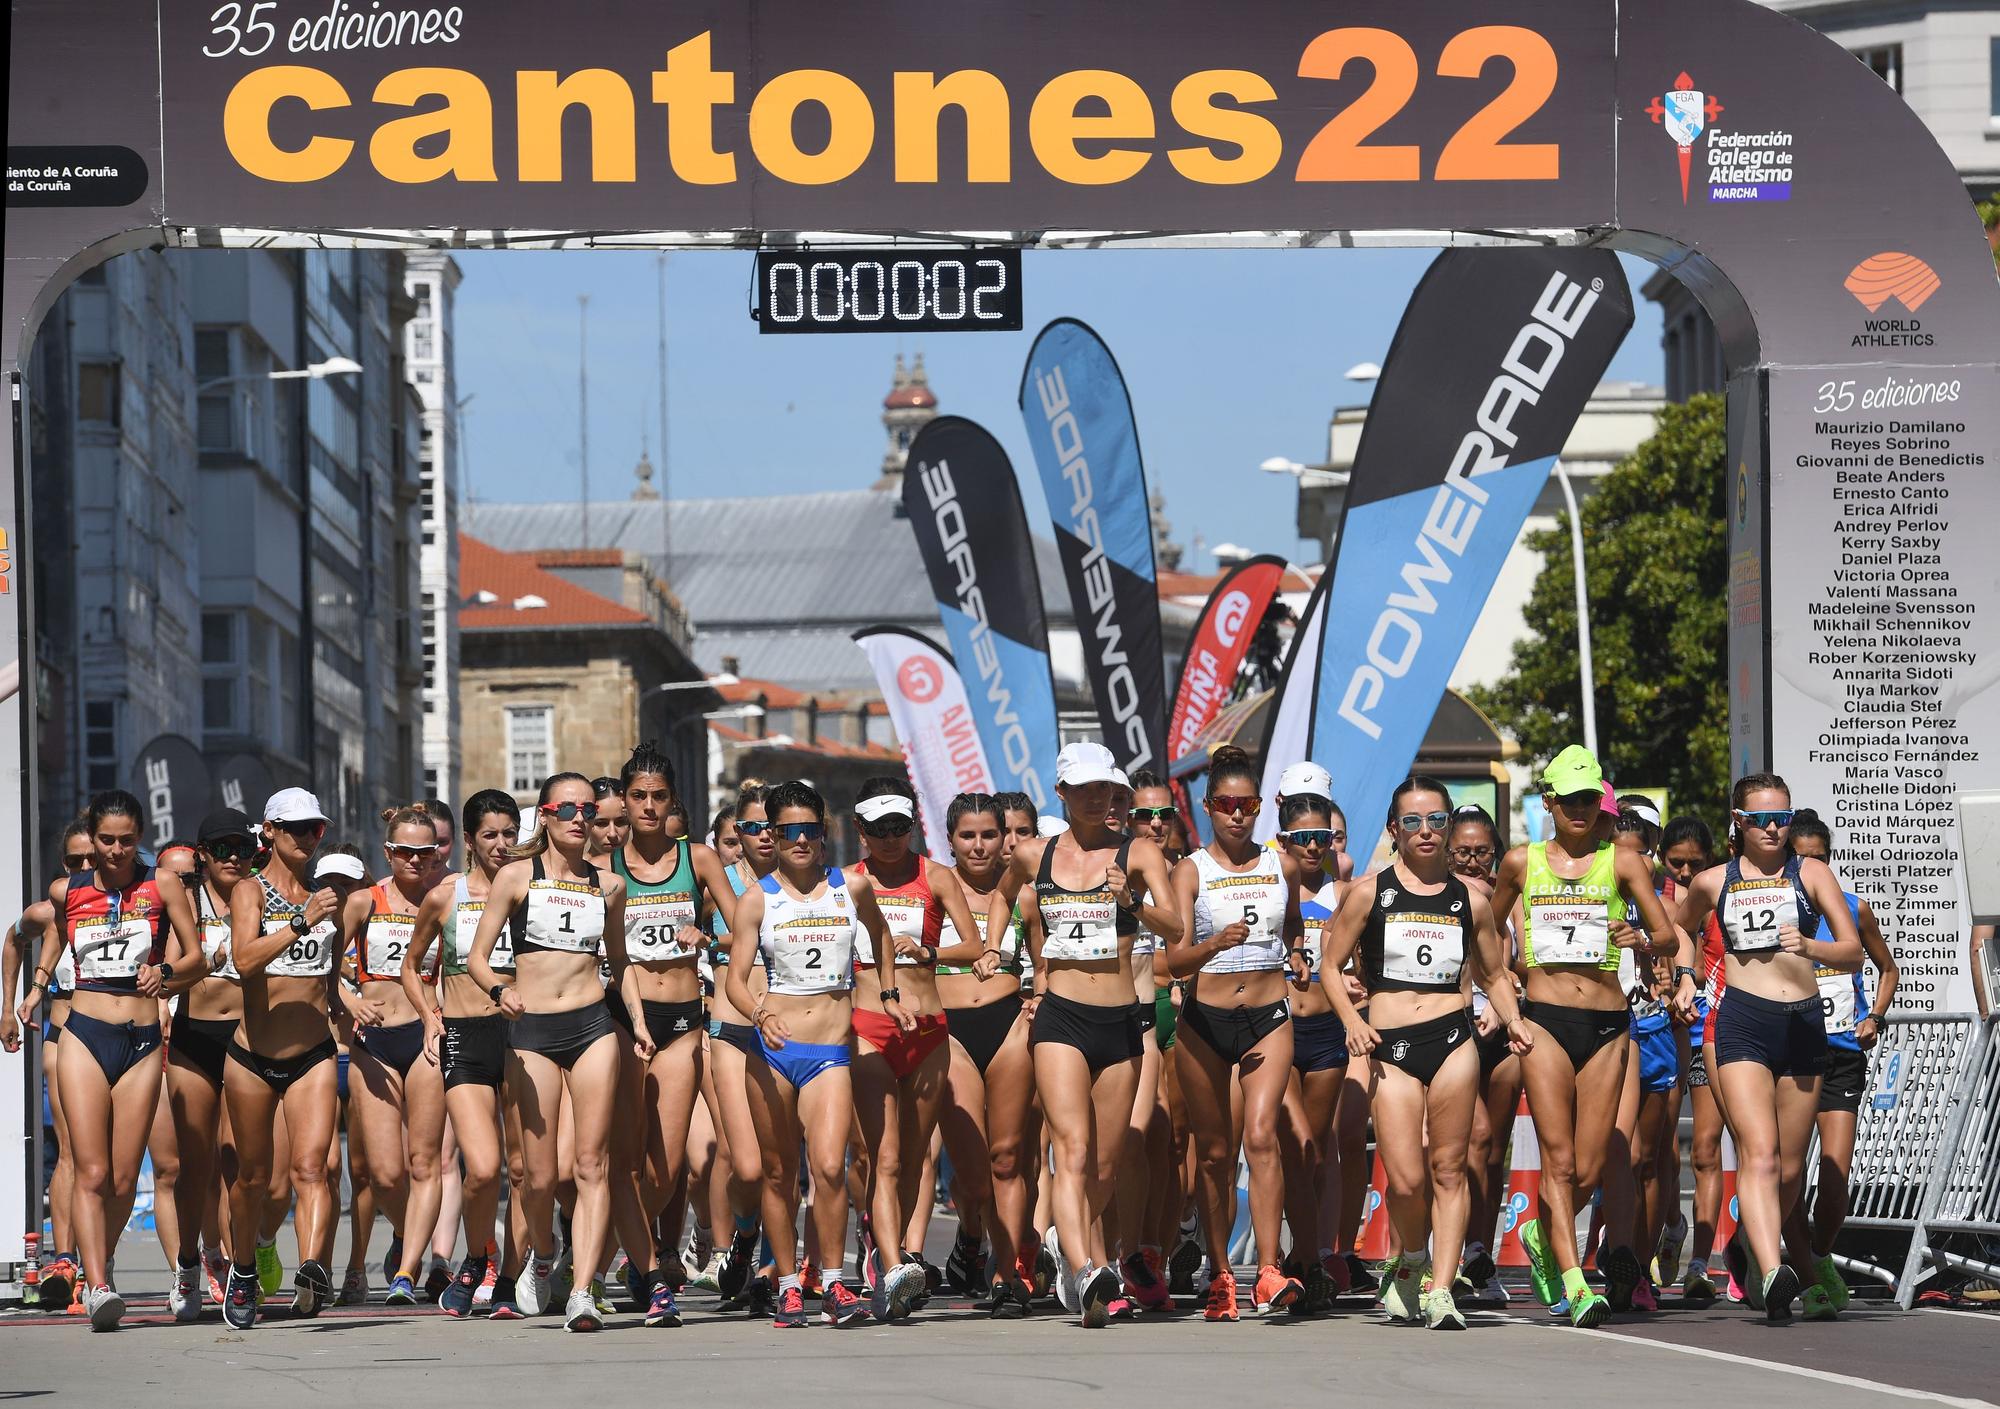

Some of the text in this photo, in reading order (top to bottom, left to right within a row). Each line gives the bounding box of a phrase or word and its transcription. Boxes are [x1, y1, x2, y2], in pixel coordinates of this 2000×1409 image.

[202, 0, 463, 58] 35 ediciones
[1675, 93, 1695, 103] FGA
[222, 27, 1560, 186] cantones22
[1707, 129, 1793, 148] Federación
[1707, 149, 1793, 169] Galega de
[43, 166, 59, 178] de
[62, 167, 72, 178] A
[74, 166, 118, 178] Coruña
[1708, 165, 1793, 184] Atletismo
[8, 180, 71, 192] da Coruña
[1712, 188, 1758, 200] MARCHA
[1865, 320, 1921, 332] WORLD
[1852, 335, 1934, 347] ATHLETICS
[1814, 377, 1960, 413] 35 ediciones
[1816, 421, 1965, 434] Maurizio Damilano
[1832, 438, 1949, 453] Reyes Sobrino
[1797, 453, 1984, 467] Giovanni de Benedictis
[1837, 471, 1945, 483] Beate Anders
[1834, 487, 1948, 499] Ernesto Canto
[1844, 503, 1937, 516] Erica Alfridi
[1834, 520, 1948, 534] Andrey Perlov
[1843, 536, 1940, 551] Kerry Saxby
[1843, 553, 1940, 565] Daniel Plaza
[1834, 569, 1949, 583] Victoria Oprea
[1827, 586, 1957, 598] Valentí Massana
[1809, 602, 1975, 614] Madeleine Svensson
[1814, 619, 1970, 631] Mikhail Schennikov
[1824, 635, 1961, 647] Yelena Nikolaeva
[1809, 651, 1976, 665] Rober Korzeniowsky
[1833, 668, 1952, 680] Annarita Sidoti
[1847, 684, 1938, 698] Ilya Markov
[1844, 700, 1942, 712] Claudia Stef
[1830, 717, 1956, 729] Jefferson Pérez
[1819, 733, 1968, 748] Olimpiada Ivanova
[1810, 749, 1978, 762] Francisco Fernández
[1846, 767, 1943, 778] María Vasco
[1833, 783, 1899, 794] Michelle
[1837, 799, 1953, 813] Cristina López
[1835, 816, 1954, 830] David Márquez
[1850, 832, 1940, 844] Rita Turava
[1833, 849, 1958, 861] Mikel Odriozola
[1840, 865, 1952, 880] Kjersti Platzer
[1530, 884, 1611, 897] ECUADOR
[1855, 882, 1938, 896] Erik Tysse
[547, 896, 586, 908] ARENAS
[1896, 898, 1957, 910] Zimmer
[1244, 905, 1259, 925] 5
[1742, 909, 1777, 933] 12
[1896, 915, 1934, 926] Yafei
[558, 911, 575, 933] 1
[641, 924, 675, 946] 30
[788, 935, 800, 943] M.
[1069, 923, 1086, 943] 4
[1562, 926, 1576, 945] 7
[1896, 931, 1958, 942] Pascual
[97, 940, 129, 961] 17
[289, 940, 318, 961] 60
[1416, 944, 1433, 966] 6
[1894, 948, 1956, 959] Borchin
[805, 948, 822, 969] 2
[1892, 999, 1934, 1011] Hong
